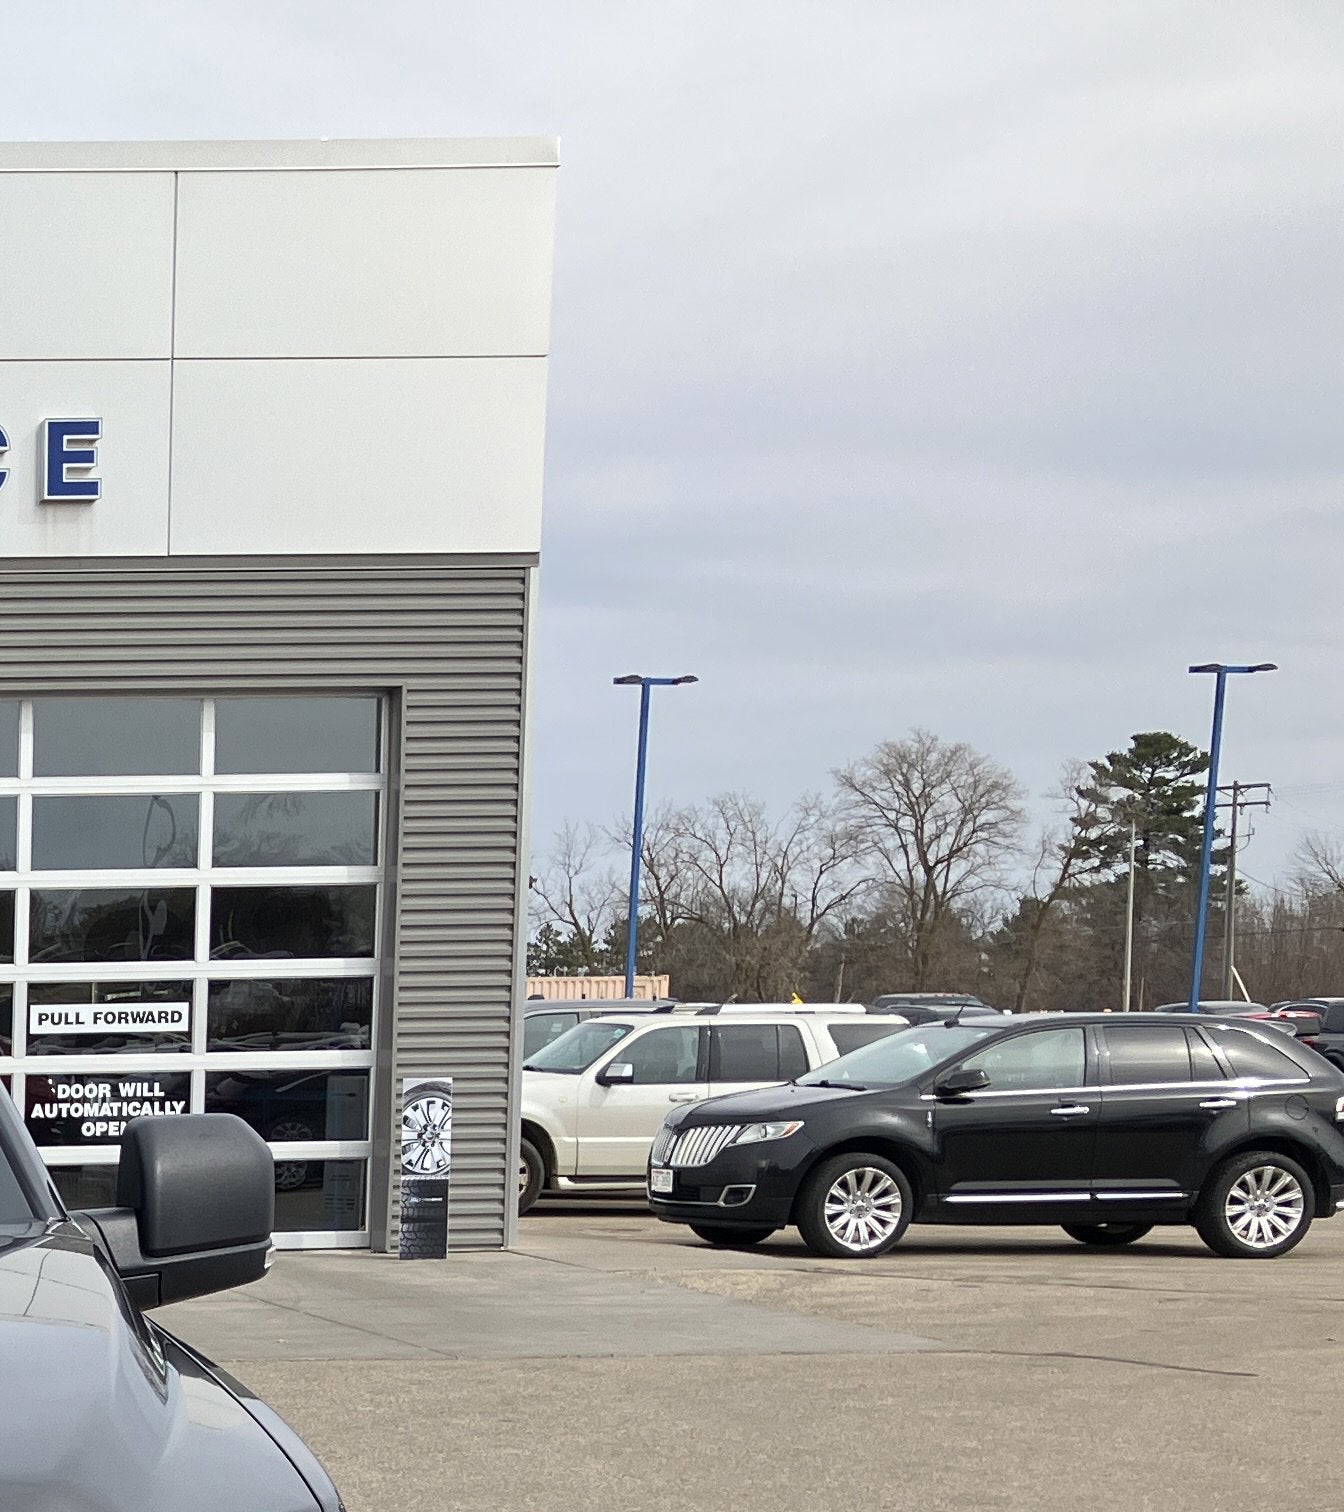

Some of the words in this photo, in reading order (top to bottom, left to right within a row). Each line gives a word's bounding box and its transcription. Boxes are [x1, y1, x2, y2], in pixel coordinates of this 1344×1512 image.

[37, 1012, 85, 1026] PULL
[92, 1010, 183, 1025] FORWARD
[57, 1083, 112, 1099] DOOR
[119, 1082, 165, 1098] WILL
[30, 1101, 186, 1119] AUTOMATICALLY
